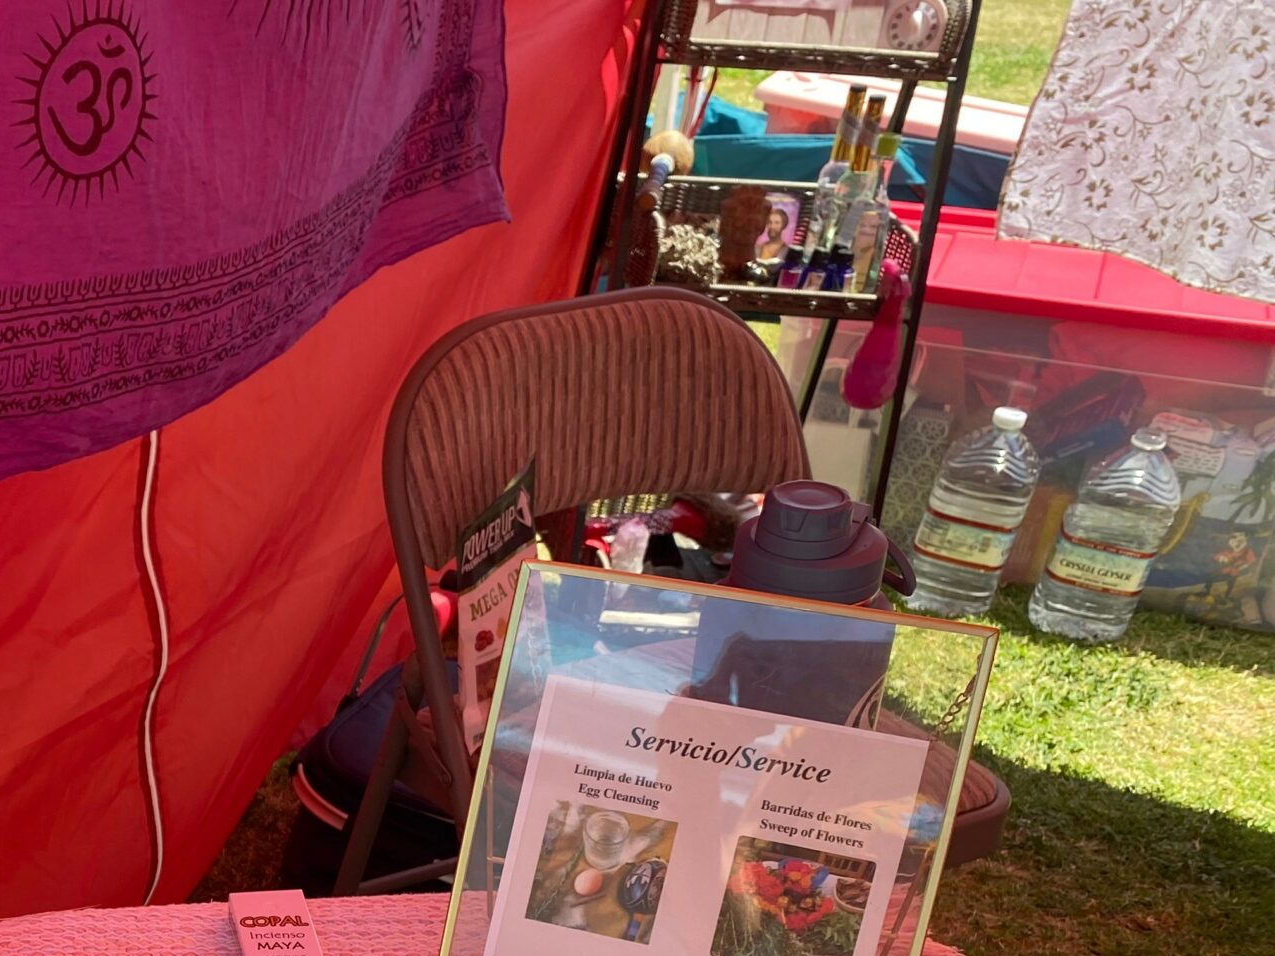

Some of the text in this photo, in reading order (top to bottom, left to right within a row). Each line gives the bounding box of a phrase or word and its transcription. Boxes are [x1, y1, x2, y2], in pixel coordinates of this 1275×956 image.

[463, 506, 515, 563] POWER UP
[1059, 558, 1095, 575] CRYSTAL
[1096, 568, 1133, 581] GEYSER
[469, 582, 508, 622] MEGA
[625, 725, 832, 783] Servicio/Service
[574, 763, 673, 793] Limpia de Huevo
[578, 783, 661, 810] Egg Cleansing
[760, 800, 873, 831] Barridas de Flores
[759, 817, 865, 849] Sweep of Flowers
[239, 915, 309, 928] COPAL
[249, 931, 305, 940] Incienso
[257, 942, 305, 950] MAYA
